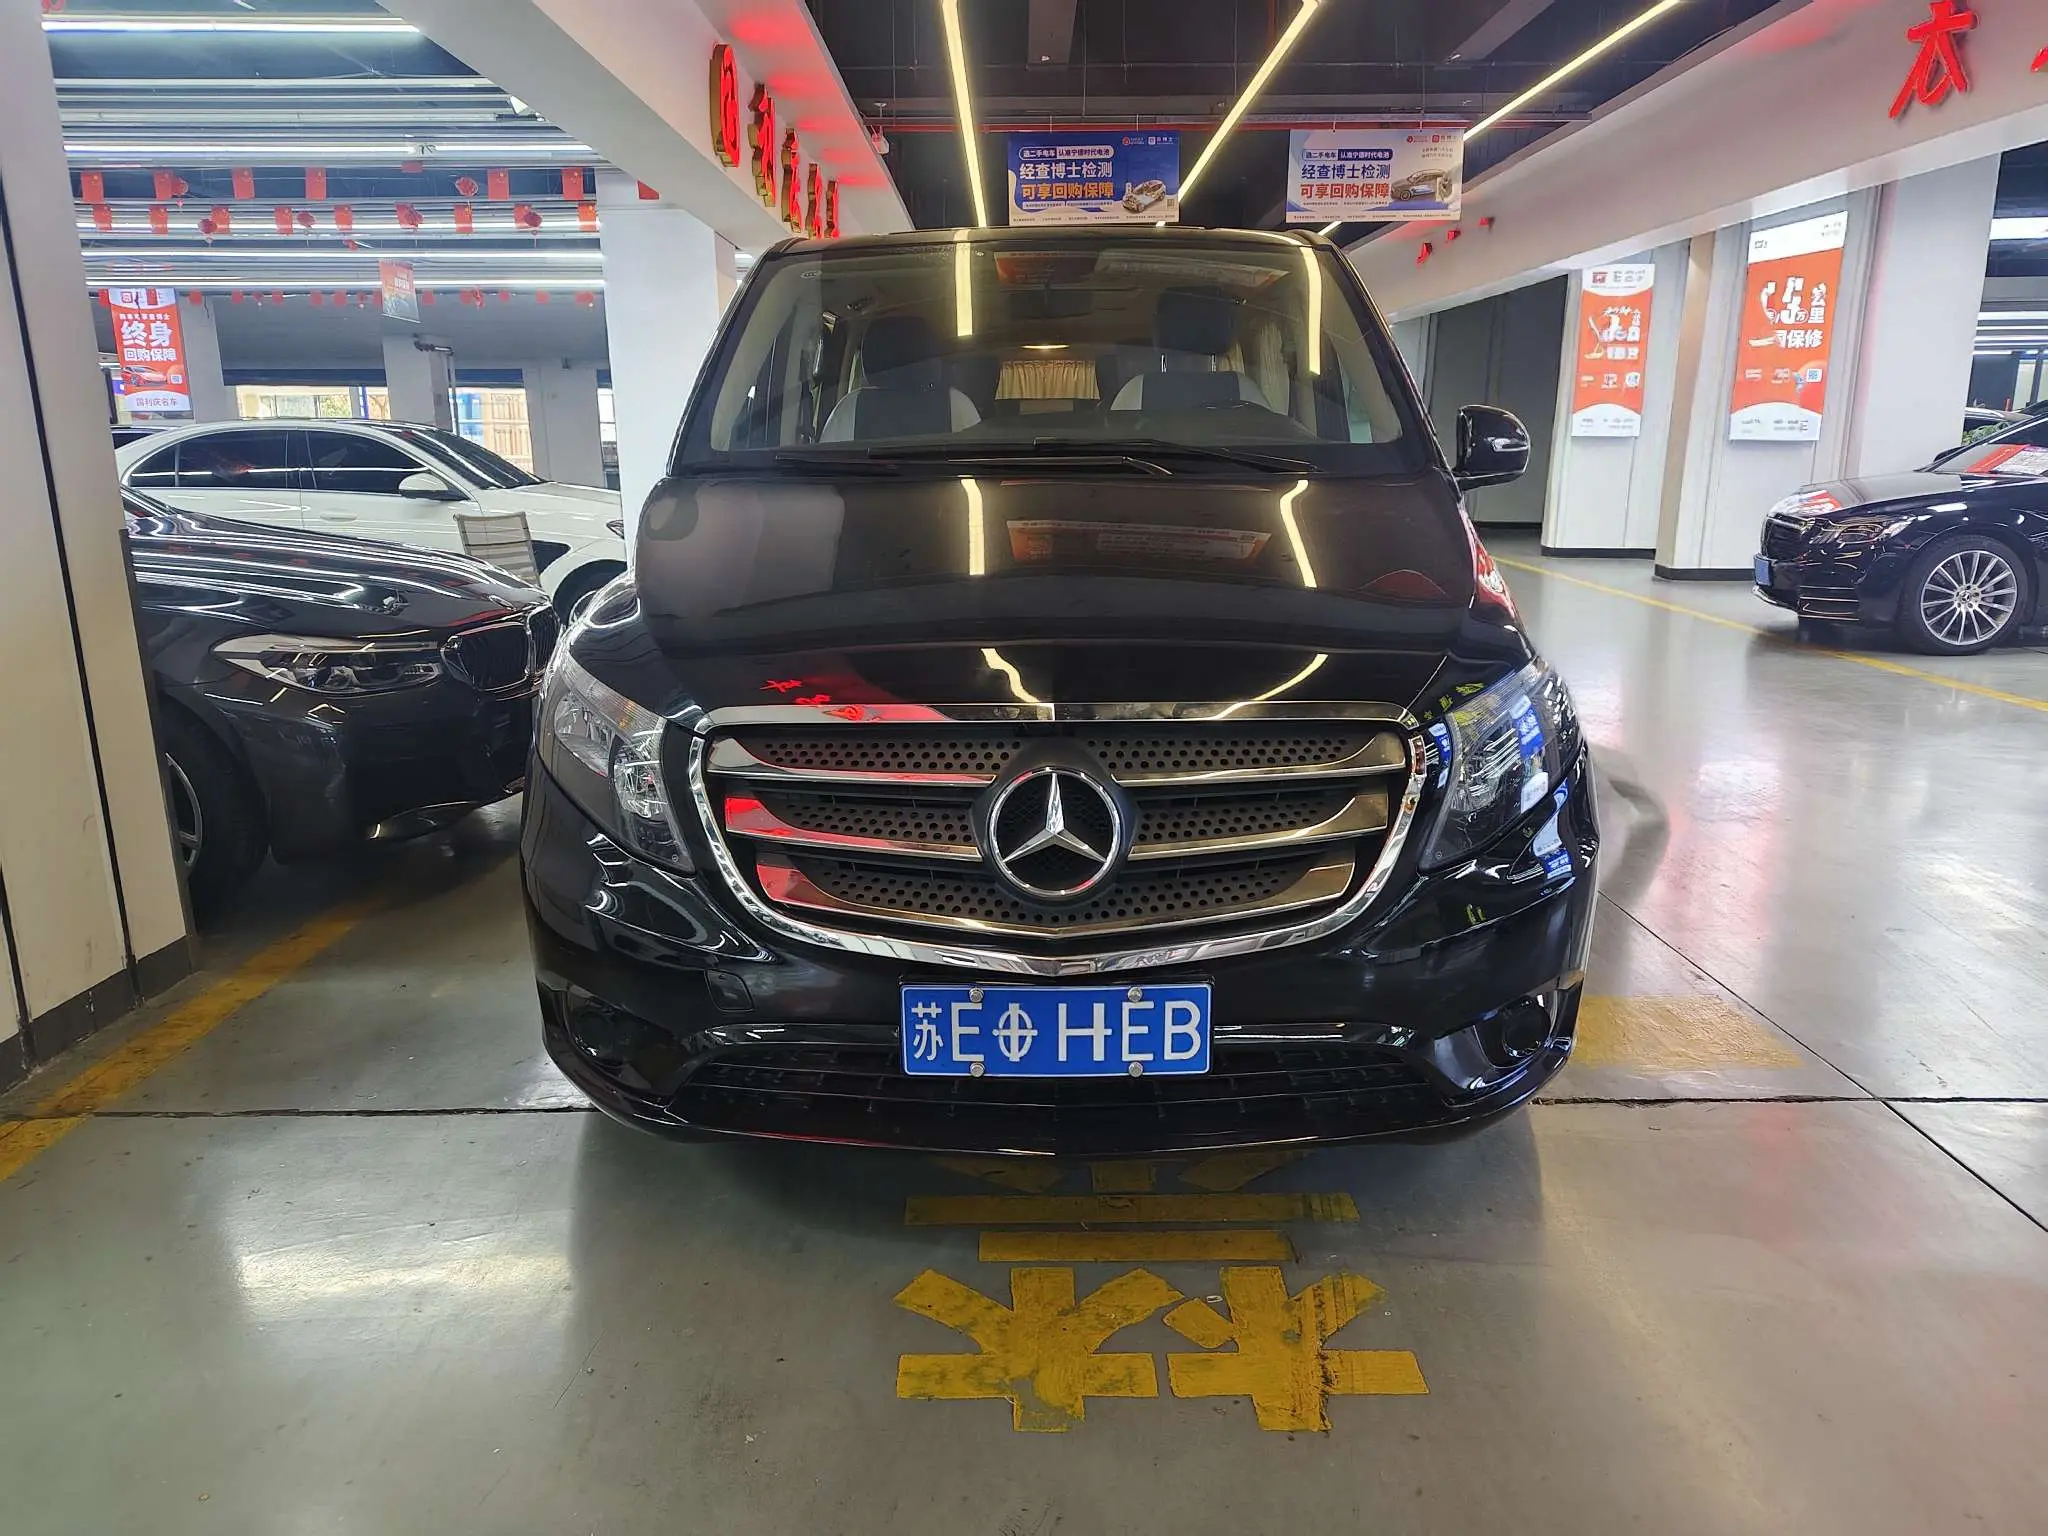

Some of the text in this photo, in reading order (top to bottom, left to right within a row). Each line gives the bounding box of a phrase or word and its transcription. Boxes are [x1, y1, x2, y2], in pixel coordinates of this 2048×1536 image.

[1019, 161, 1113, 179] 经查博士检测
[1301, 163, 1391, 180] 经查博士检测
[1021, 181, 1114, 200] 可享回购保障
[1300, 182, 1390, 199] 可享回购保障
[120, 320, 173, 347] 终身
[123, 347, 178, 362] 回购保障
